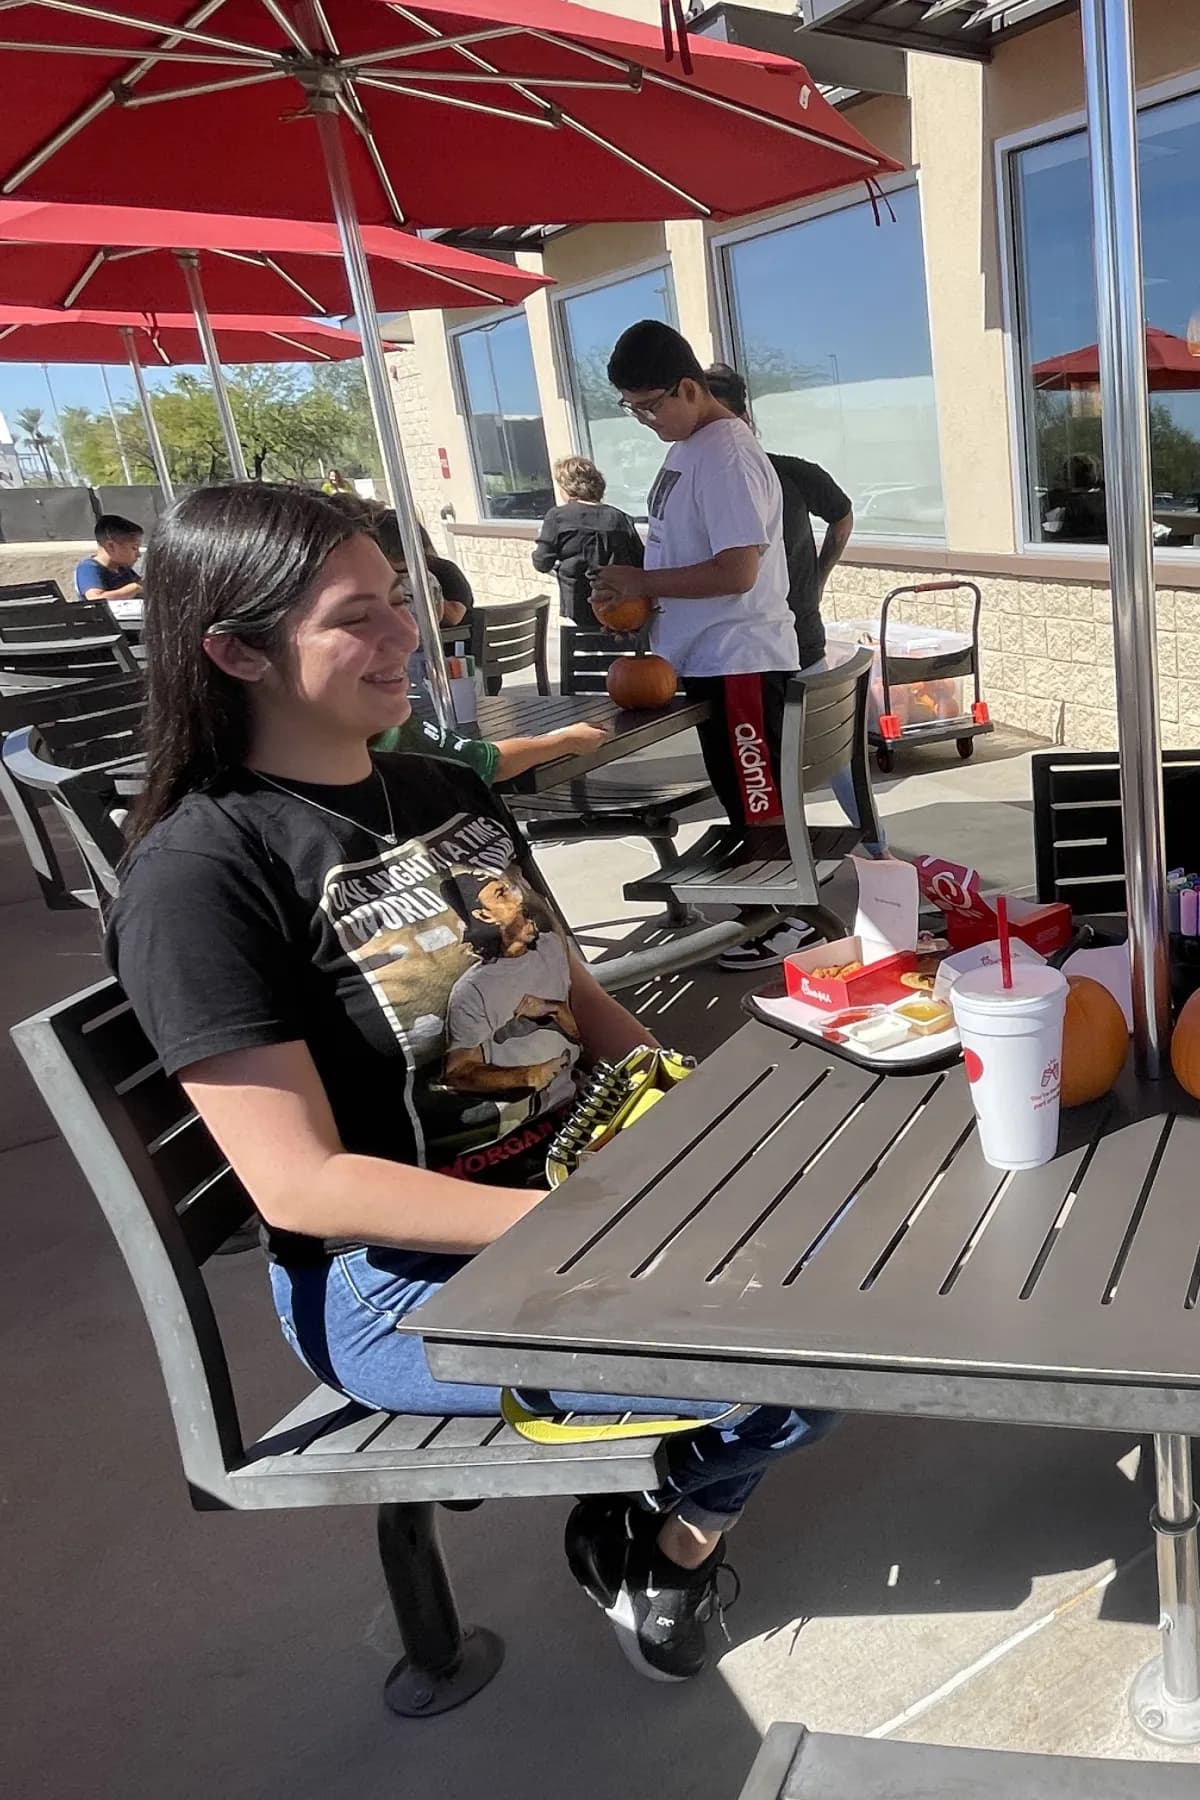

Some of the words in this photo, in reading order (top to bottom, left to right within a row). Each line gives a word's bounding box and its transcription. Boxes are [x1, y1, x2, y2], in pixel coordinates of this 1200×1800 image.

[734, 723, 772, 812] akdmks
[440, 840, 471, 861] A
[455, 817, 502, 848] TIME
[366, 853, 438, 894] NIGHT
[328, 880, 378, 911] ONE
[341, 887, 449, 943] WORLD
